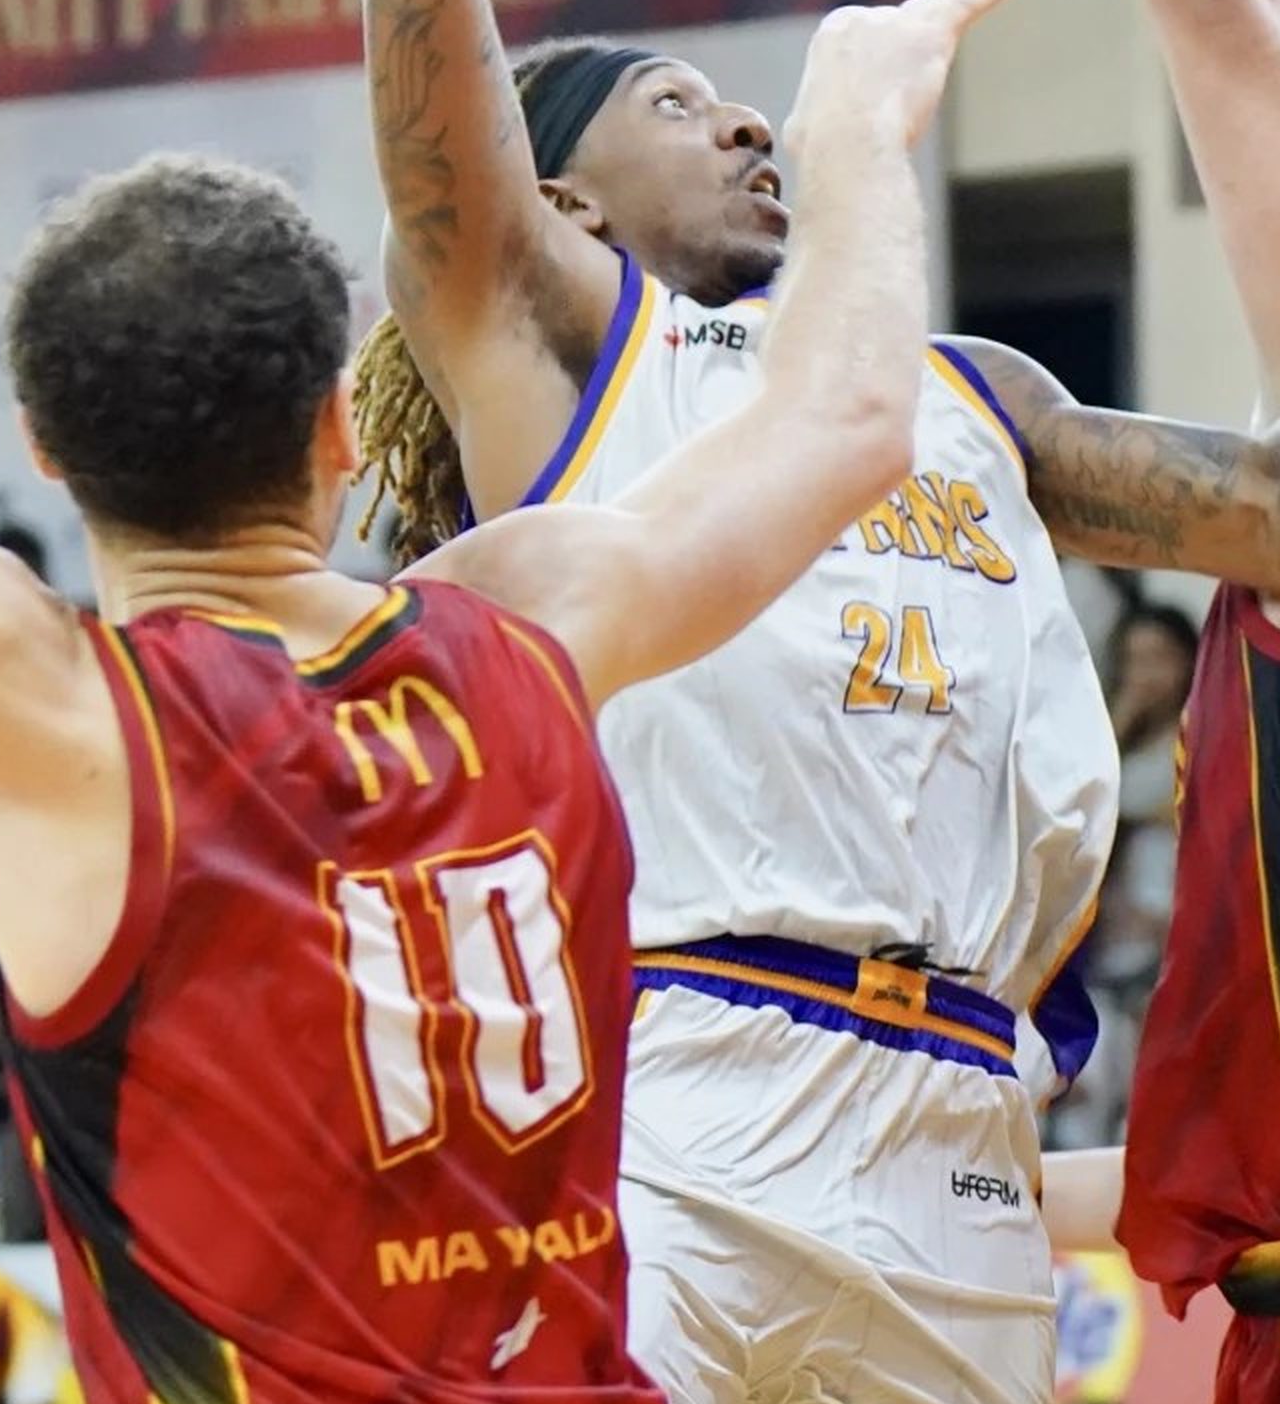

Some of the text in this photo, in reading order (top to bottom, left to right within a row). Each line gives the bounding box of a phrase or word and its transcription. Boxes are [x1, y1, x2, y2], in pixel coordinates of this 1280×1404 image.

[684, 319, 747, 350] MSB
[842, 601, 956, 715] 24
[320, 828, 595, 1171] 10
